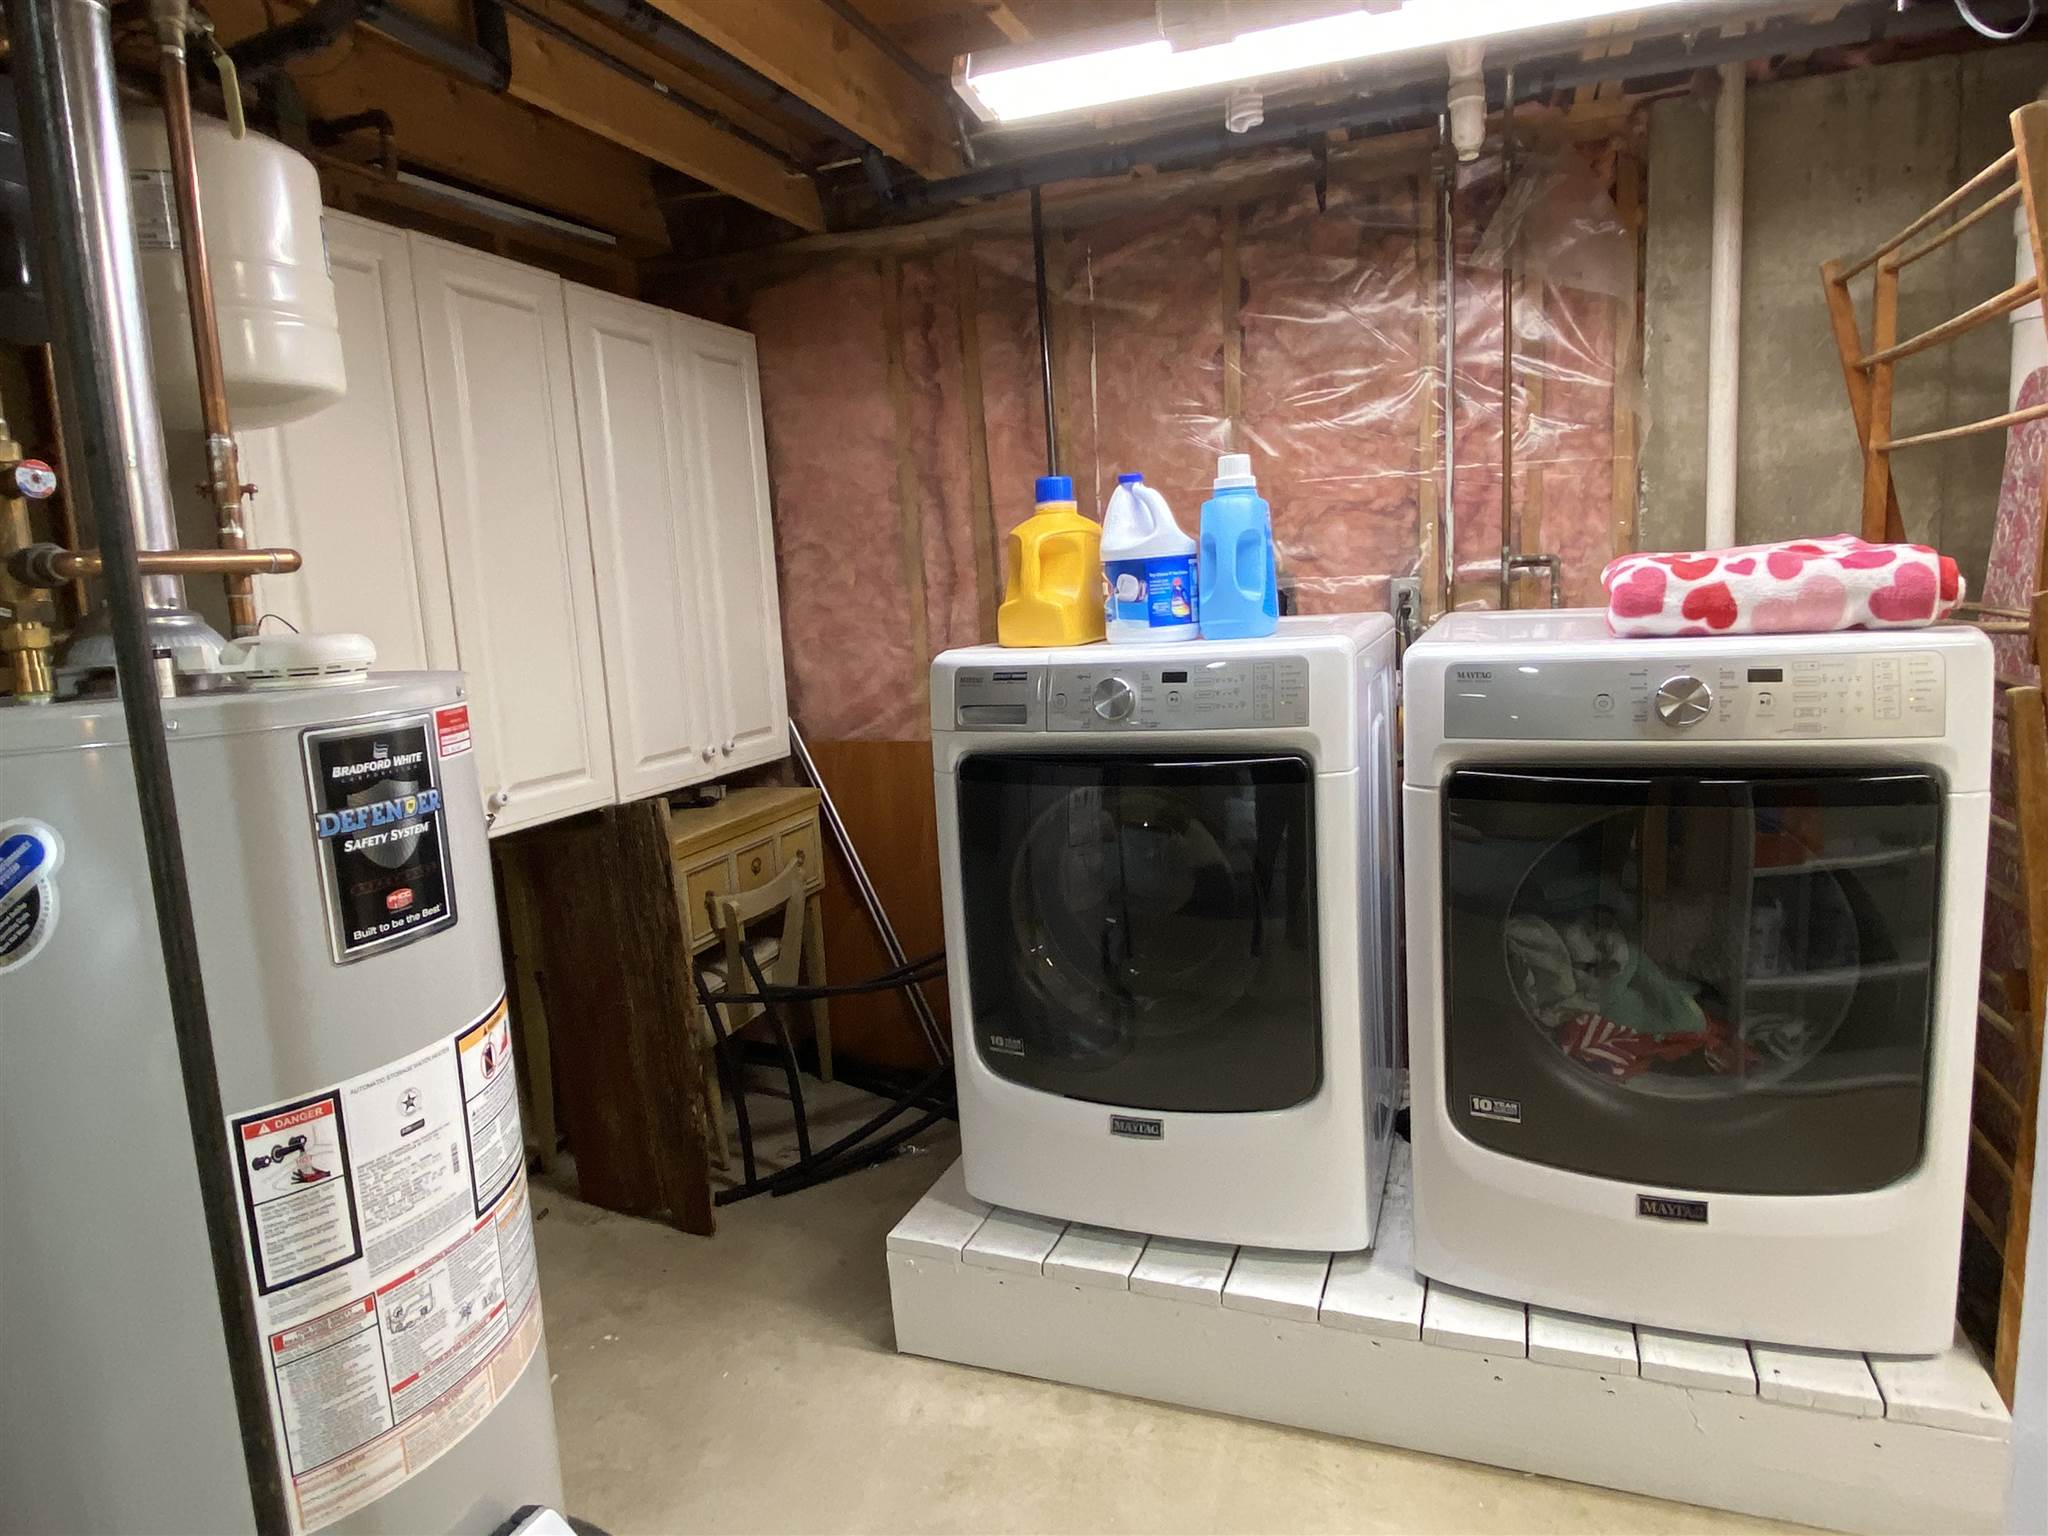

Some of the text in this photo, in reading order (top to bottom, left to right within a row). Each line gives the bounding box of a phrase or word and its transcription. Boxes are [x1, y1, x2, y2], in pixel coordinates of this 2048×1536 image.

[332, 751, 423, 778] BRADFORD WHITE
[318, 790, 442, 838] DEFENDER
[344, 821, 429, 852] SAFETY SYSTEM
[353, 904, 441, 940] Built to be the Best
[275, 1106, 324, 1130] DANGER
[1472, 1097, 1492, 1112] 10
[1113, 1119, 1160, 1136] MAYTAG
